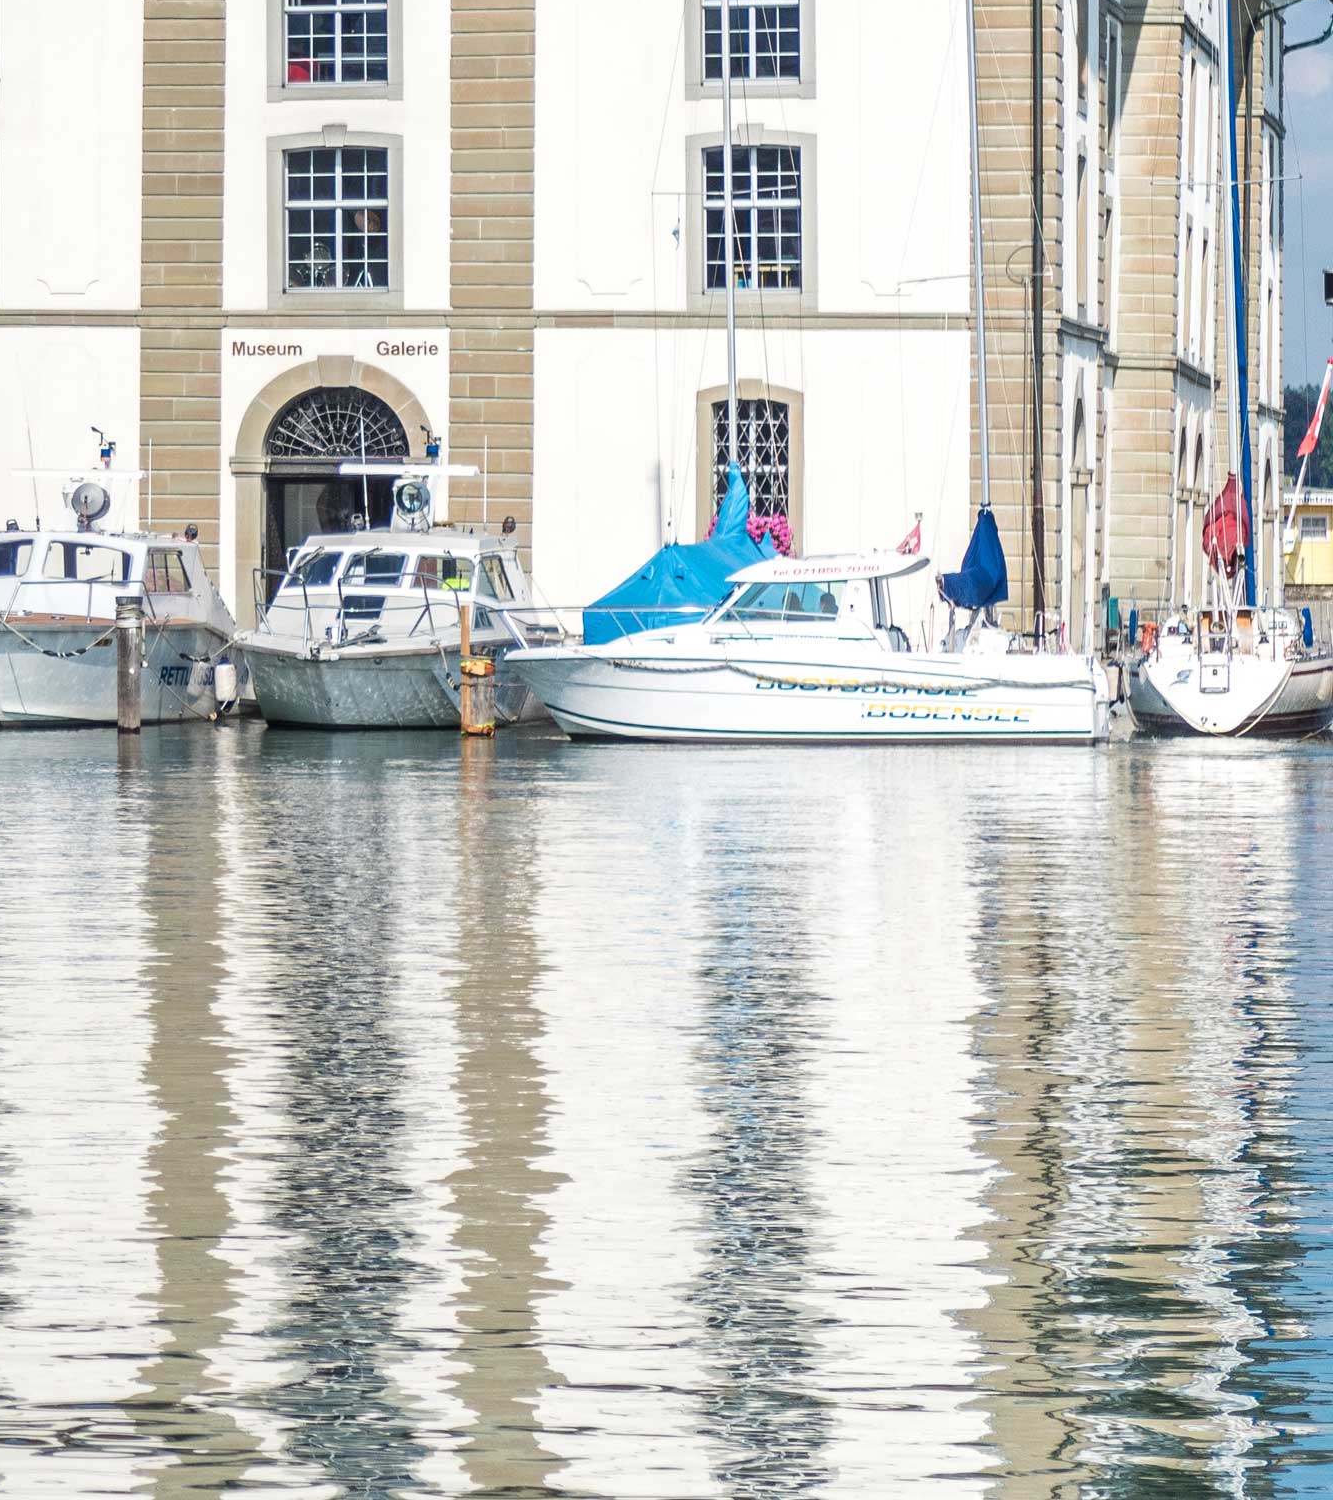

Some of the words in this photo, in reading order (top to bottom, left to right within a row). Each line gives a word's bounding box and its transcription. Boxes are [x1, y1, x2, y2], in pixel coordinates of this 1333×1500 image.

[232, 341, 303, 356] Museum
[376, 341, 439, 356] Galerie
[866, 703, 1032, 723] BODENSEE
